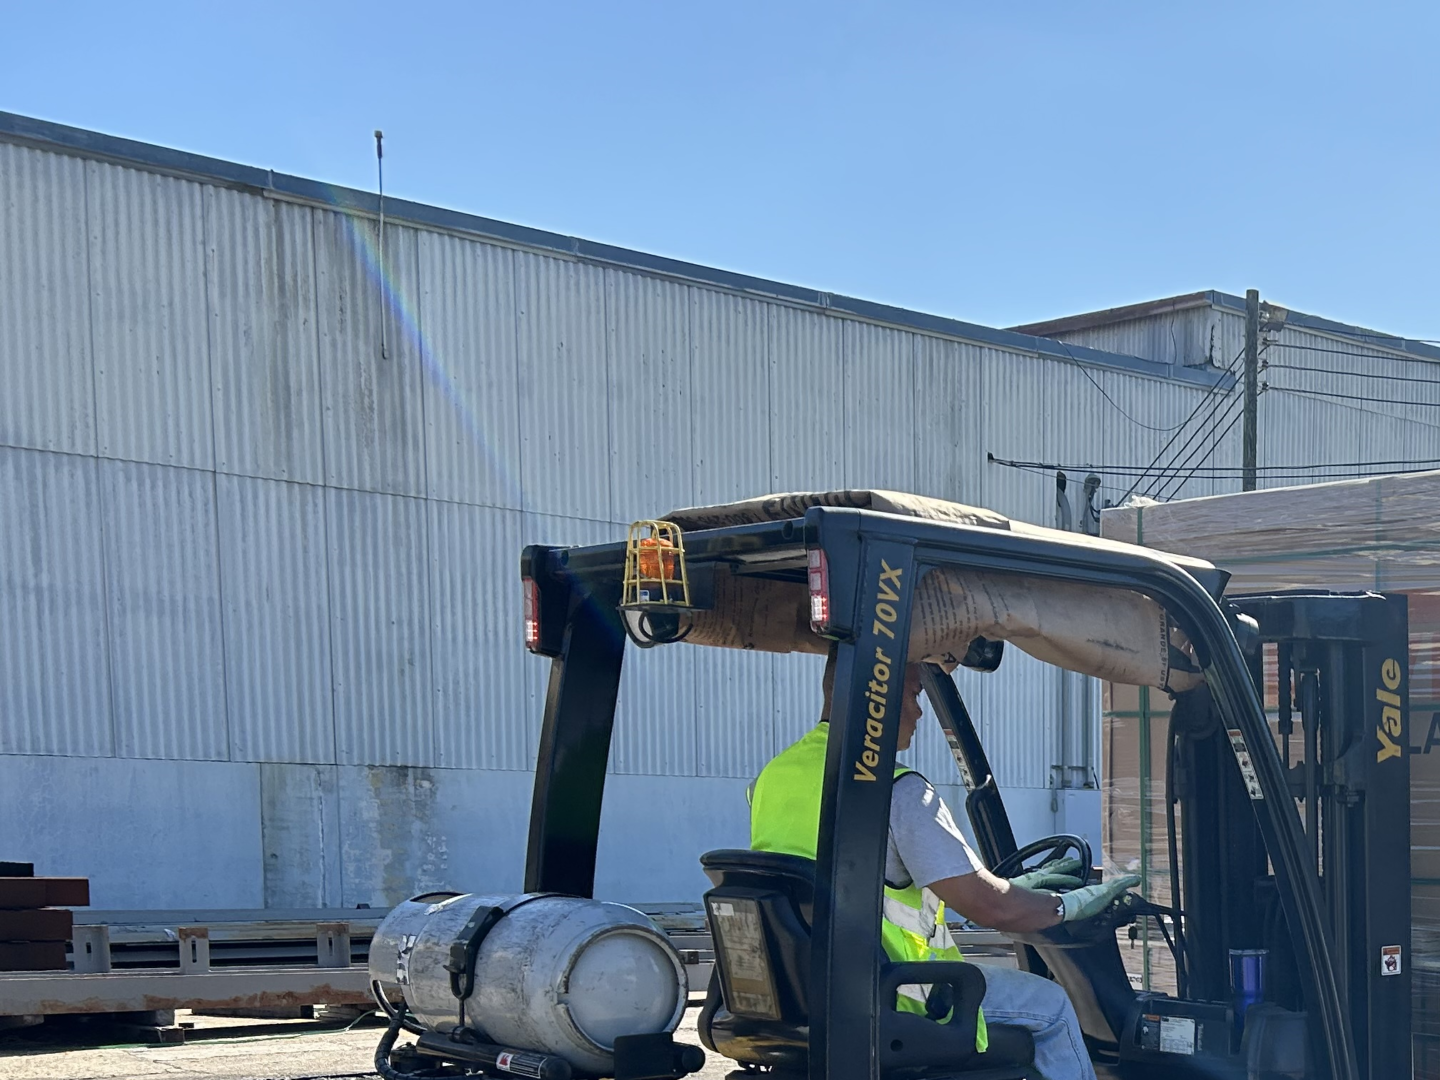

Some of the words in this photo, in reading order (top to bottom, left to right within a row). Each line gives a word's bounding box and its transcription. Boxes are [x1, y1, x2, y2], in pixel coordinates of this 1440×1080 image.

[853, 647, 892, 783] Veracitor
[873, 559, 902, 640] 70VX
[1376, 658, 1401, 763] Yale
